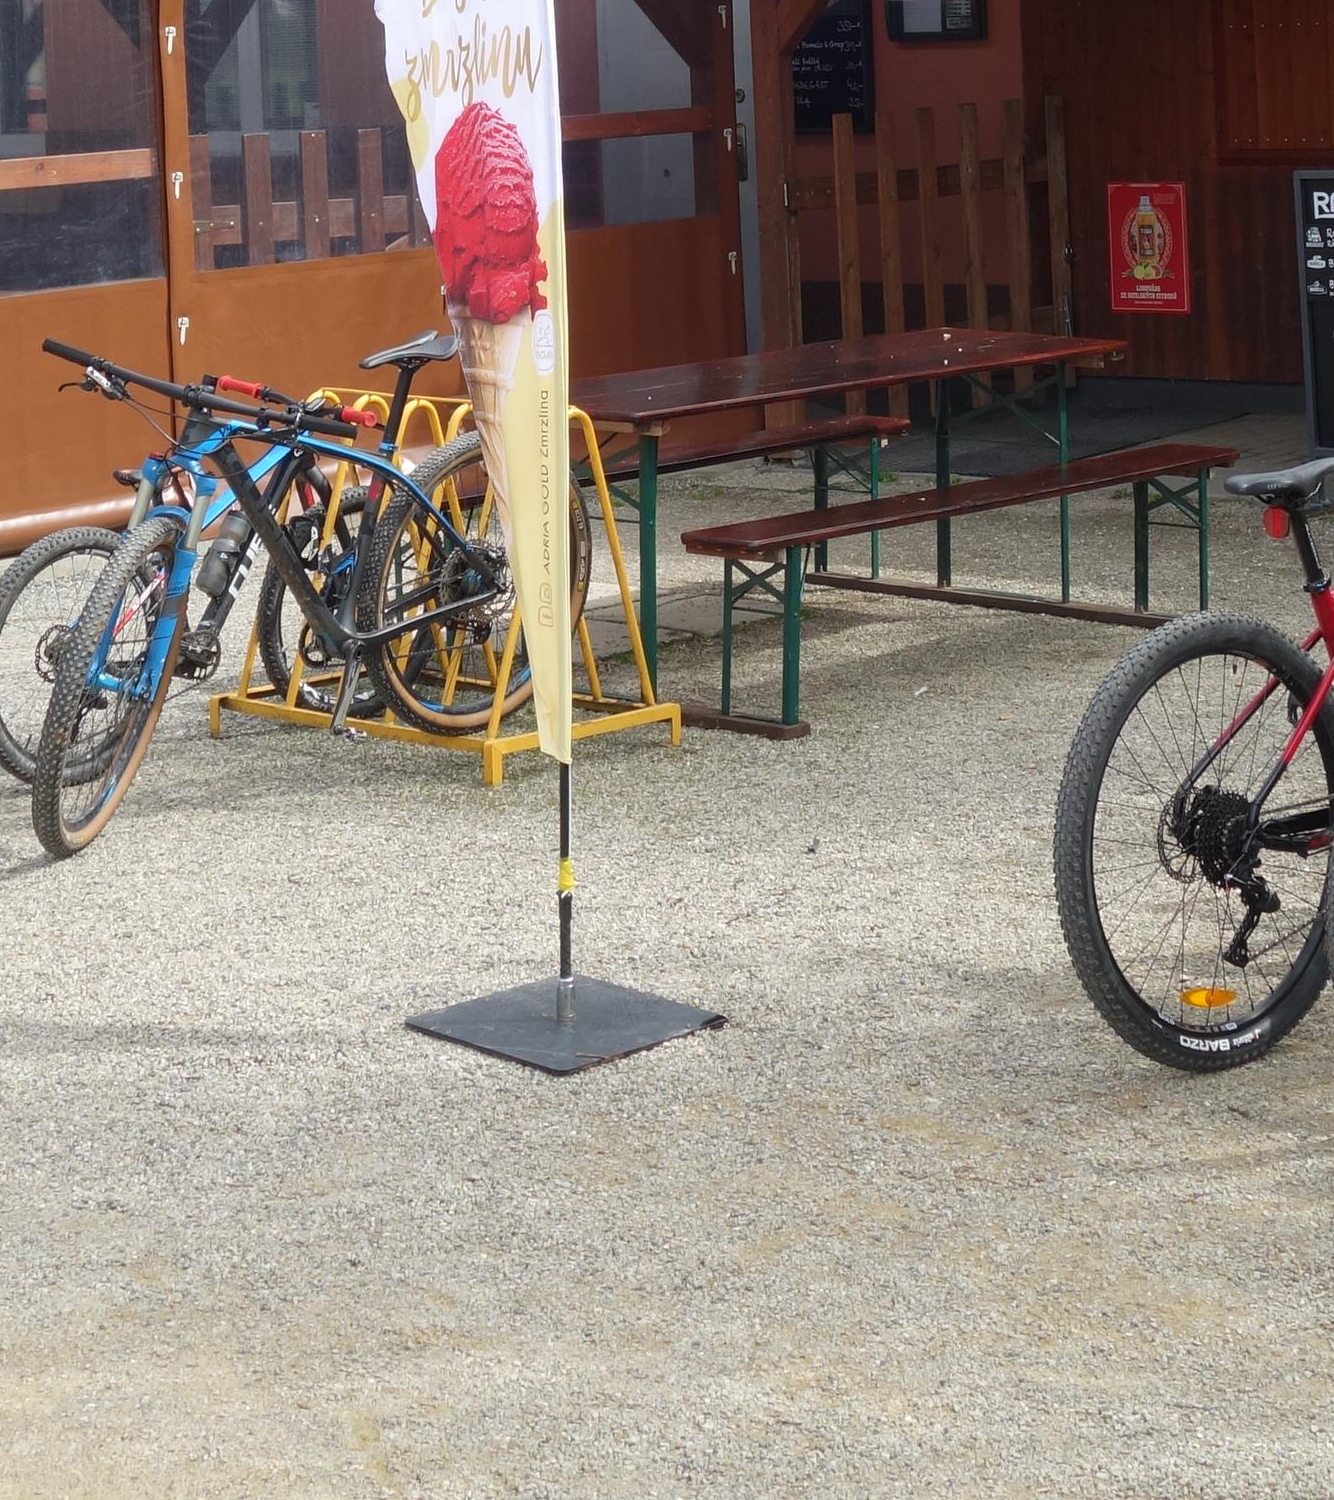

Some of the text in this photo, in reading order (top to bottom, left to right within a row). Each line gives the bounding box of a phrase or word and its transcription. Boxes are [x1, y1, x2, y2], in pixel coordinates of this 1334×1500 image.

[405, 13, 543, 123] zmrzlinu
[539, 390, 549, 459] Zmrzlina
[542, 520, 551, 576] ADRIA
[1179, 1034, 1231, 1052] BARZO
